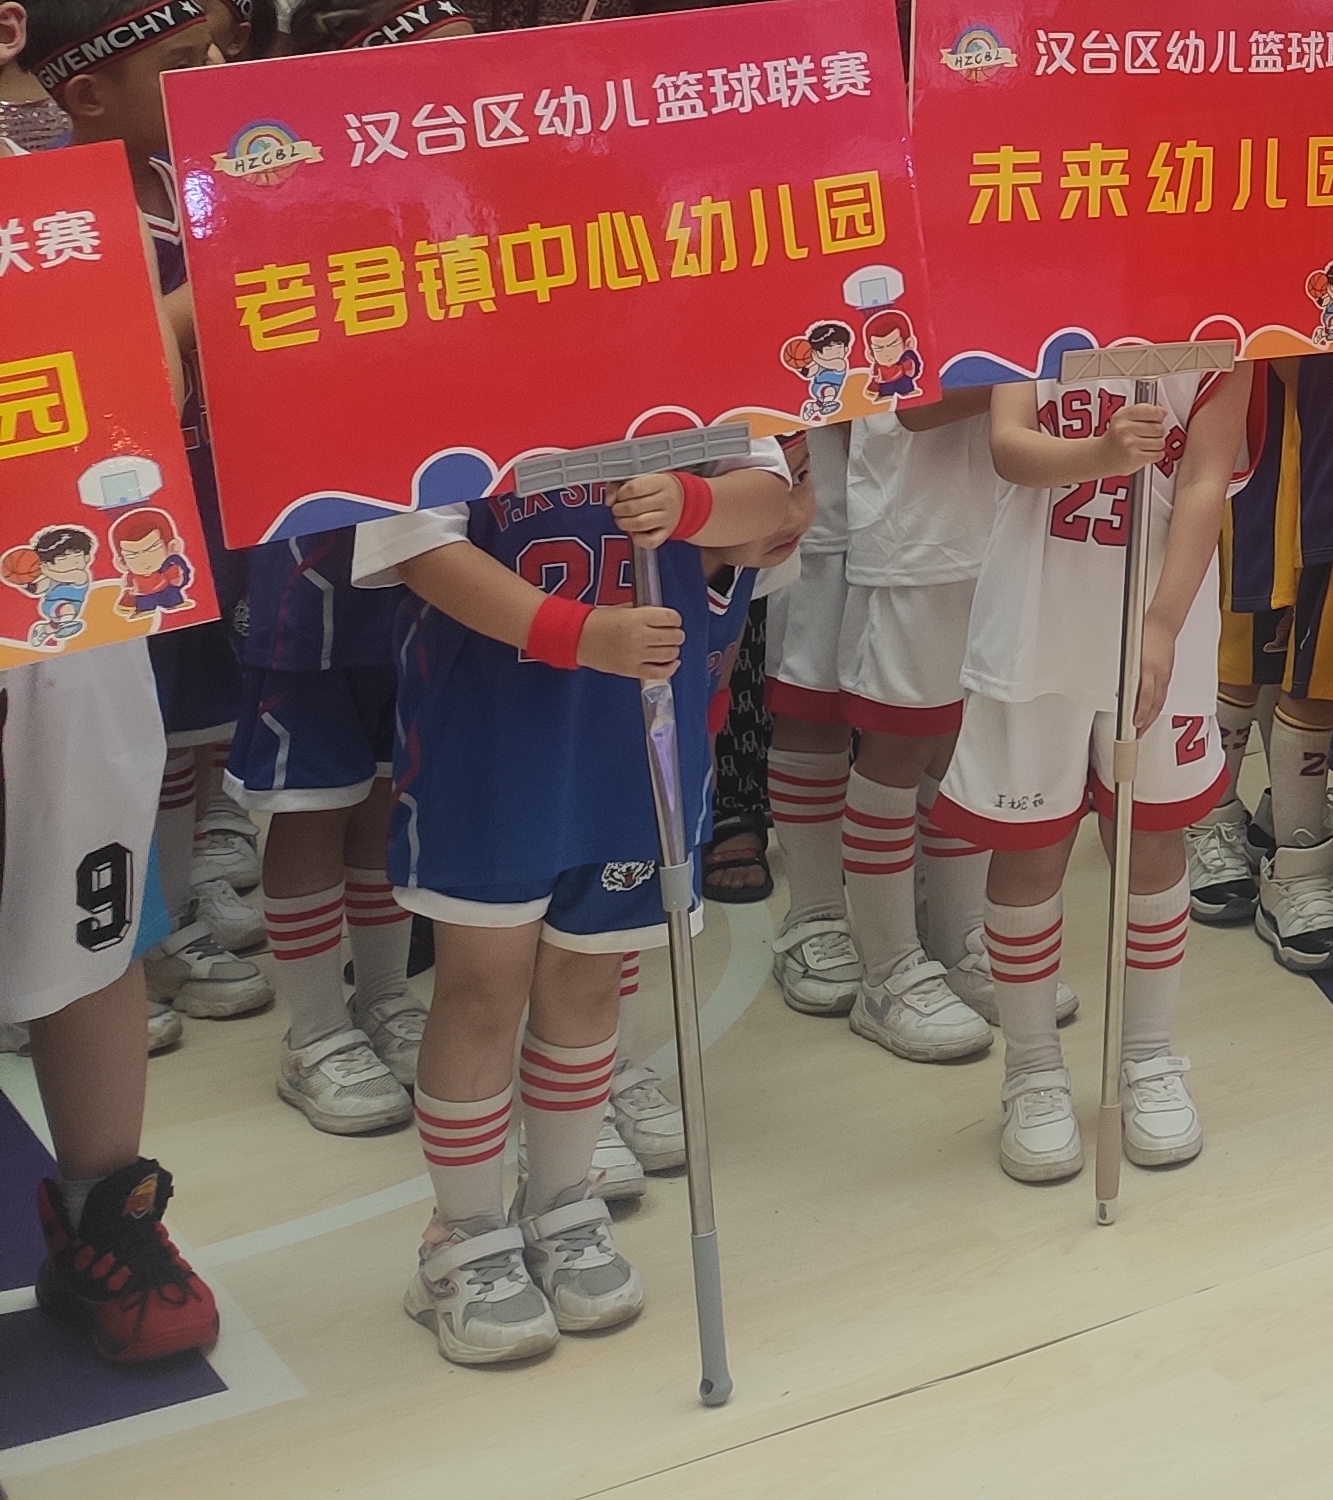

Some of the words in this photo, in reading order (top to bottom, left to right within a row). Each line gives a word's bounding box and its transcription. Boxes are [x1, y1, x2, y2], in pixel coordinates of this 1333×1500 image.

[37, 5, 176, 91] GIVEMCHY
[233, 143, 300, 173] HZCBL
[345, 48, 873, 168] 汉台区幼儿篮球联赛
[232, 170, 886, 352] 老君镇中心幼儿园
[74, 840, 134, 954] 9
